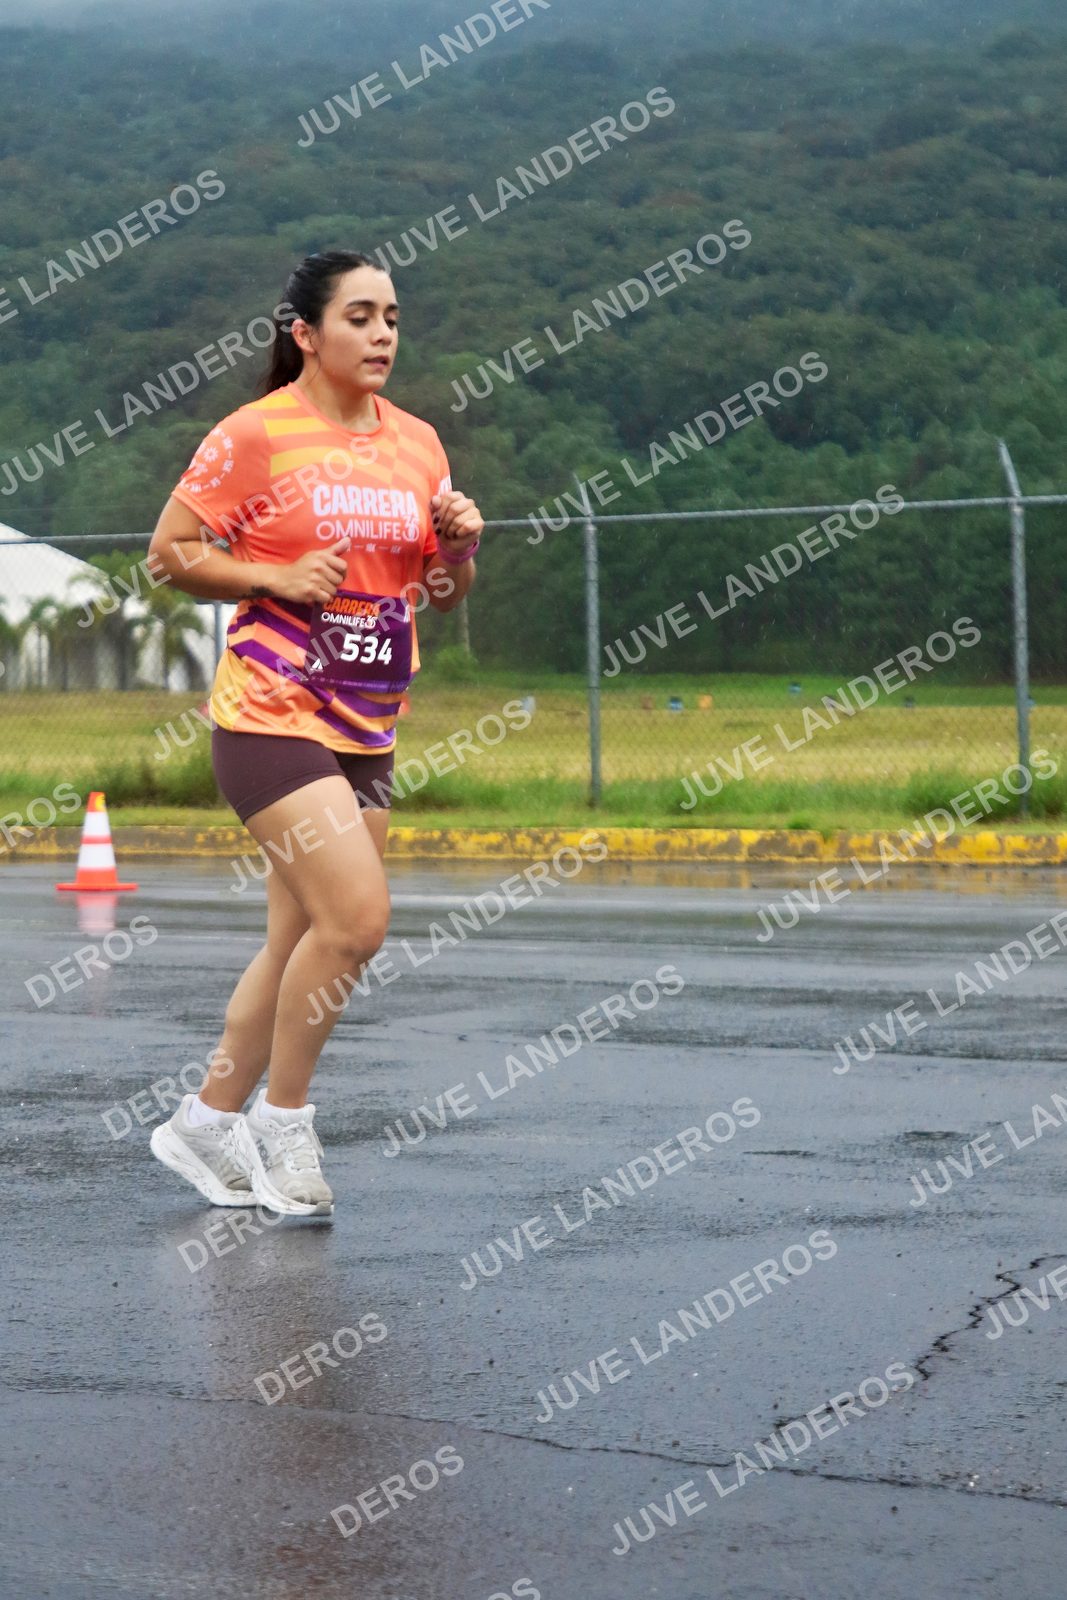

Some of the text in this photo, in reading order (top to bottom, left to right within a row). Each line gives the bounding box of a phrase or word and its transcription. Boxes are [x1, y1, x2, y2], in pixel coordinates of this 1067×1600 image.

[312, 484, 419, 519] CARRERA
[315, 519, 402, 541] OMNILIFE
[323, 597, 381, 616] CARRERA
[321, 612, 365, 628] OMNILIFE
[340, 633, 393, 665] 534
